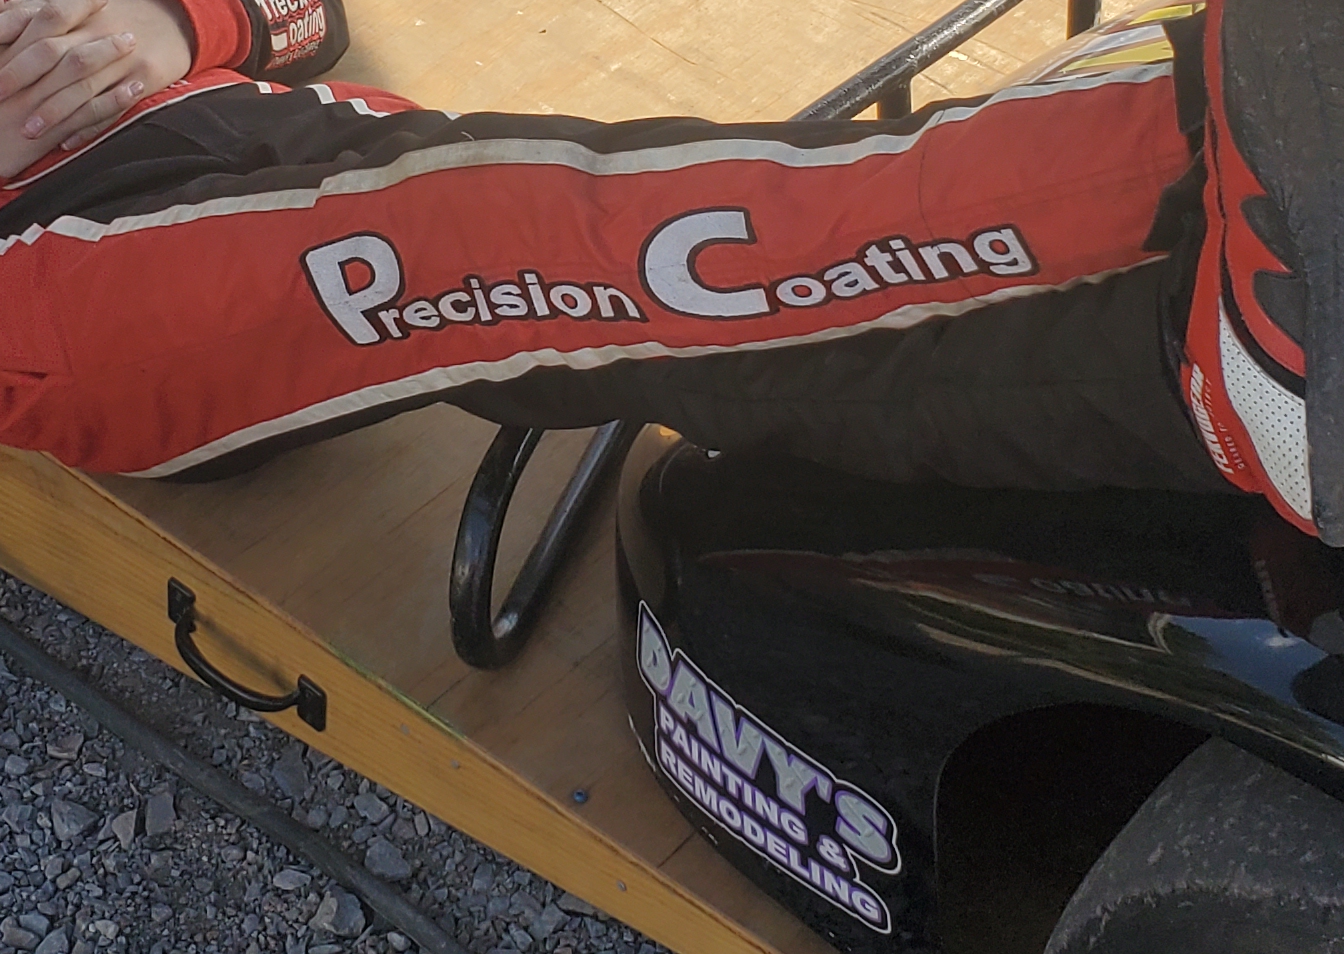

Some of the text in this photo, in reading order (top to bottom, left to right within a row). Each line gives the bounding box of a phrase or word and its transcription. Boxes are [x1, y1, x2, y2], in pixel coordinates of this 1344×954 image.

[303, 209, 1035, 346] Precision Coating
[640, 608, 893, 864] DAVY'S
[659, 706, 851, 874] PAINTING &
[659, 738, 883, 924] REMODELING
